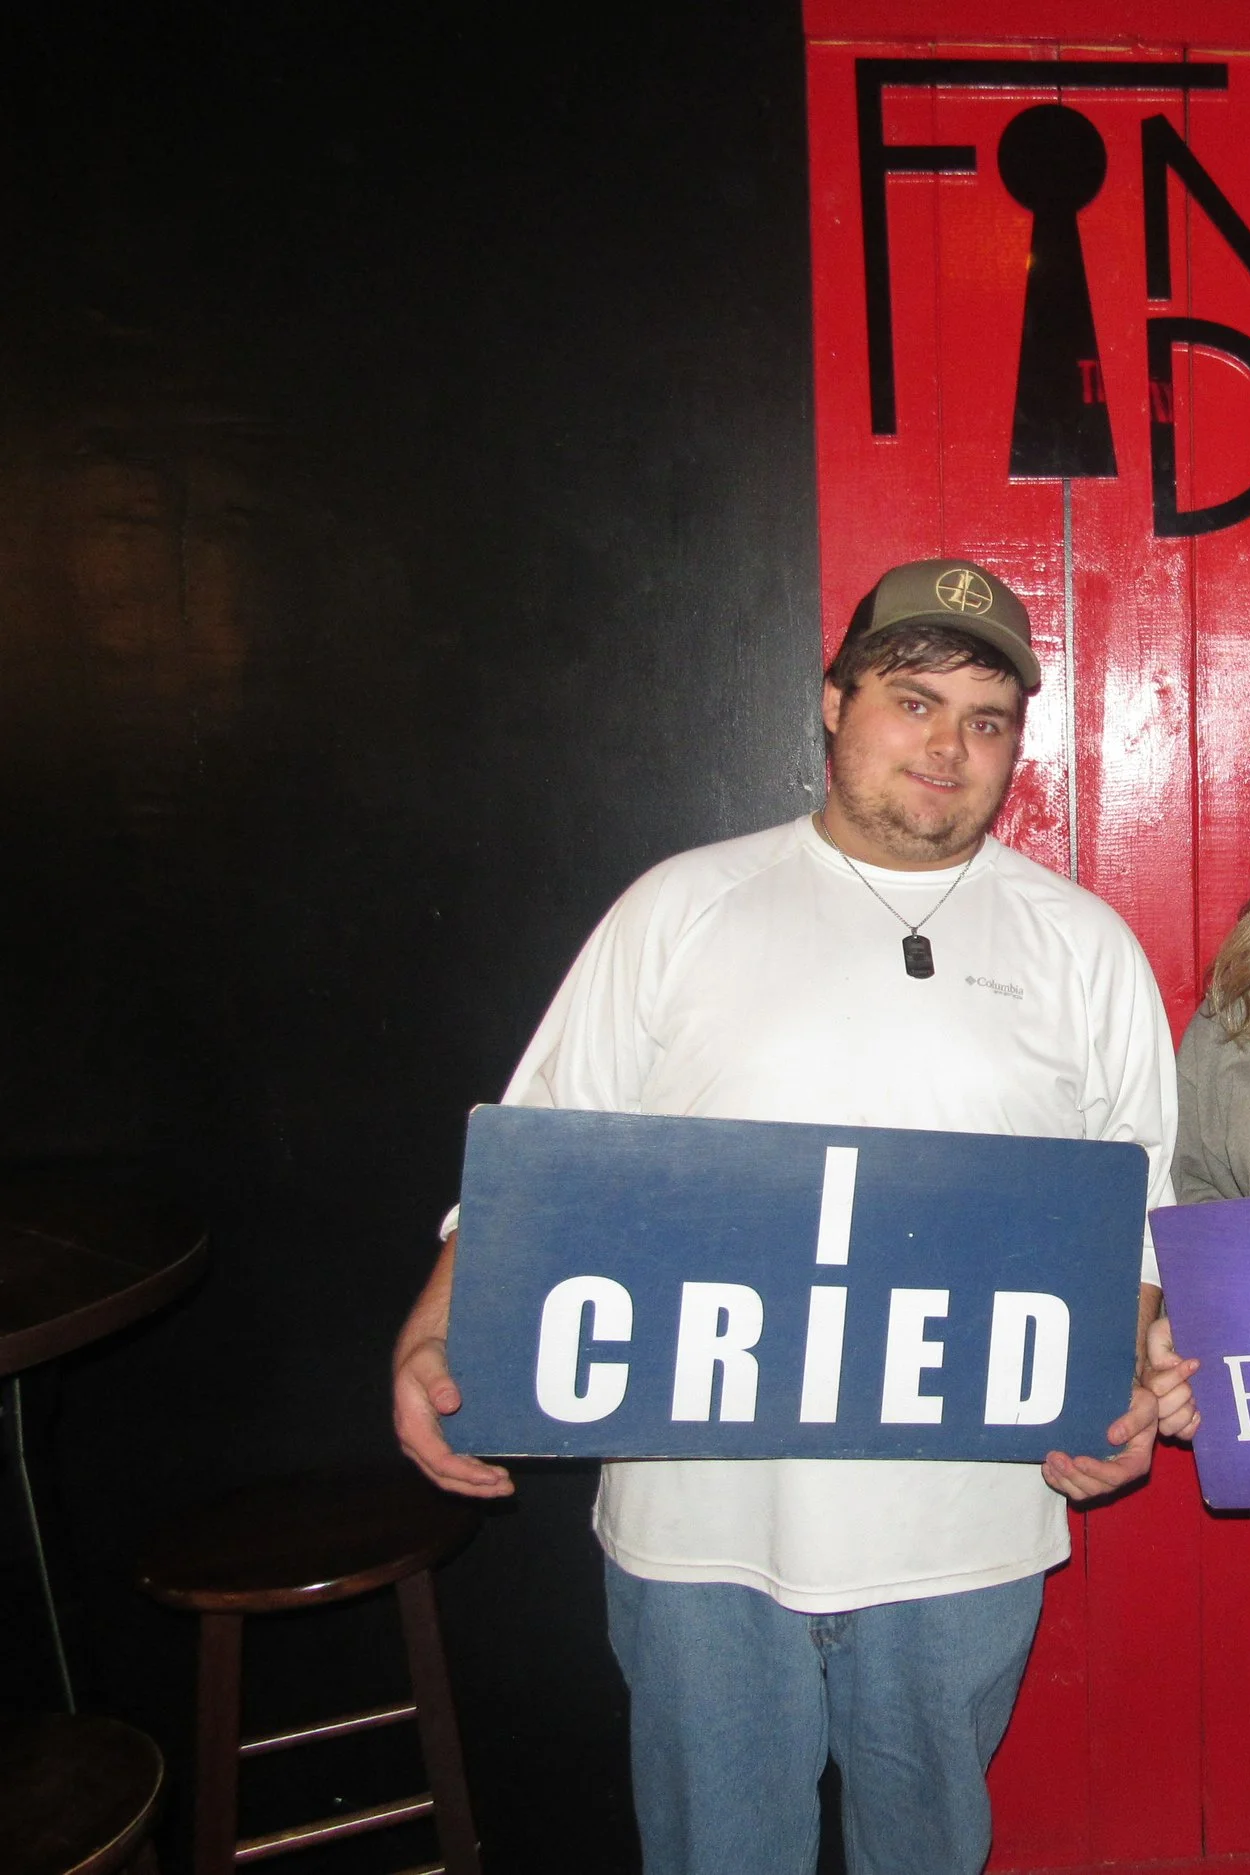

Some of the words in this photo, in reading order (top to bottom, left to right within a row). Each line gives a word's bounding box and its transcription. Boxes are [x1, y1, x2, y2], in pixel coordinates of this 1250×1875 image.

[977, 976, 1025, 996] Columbia
[815, 1146, 859, 1266] I
[535, 1275, 1071, 1425] CRIED
